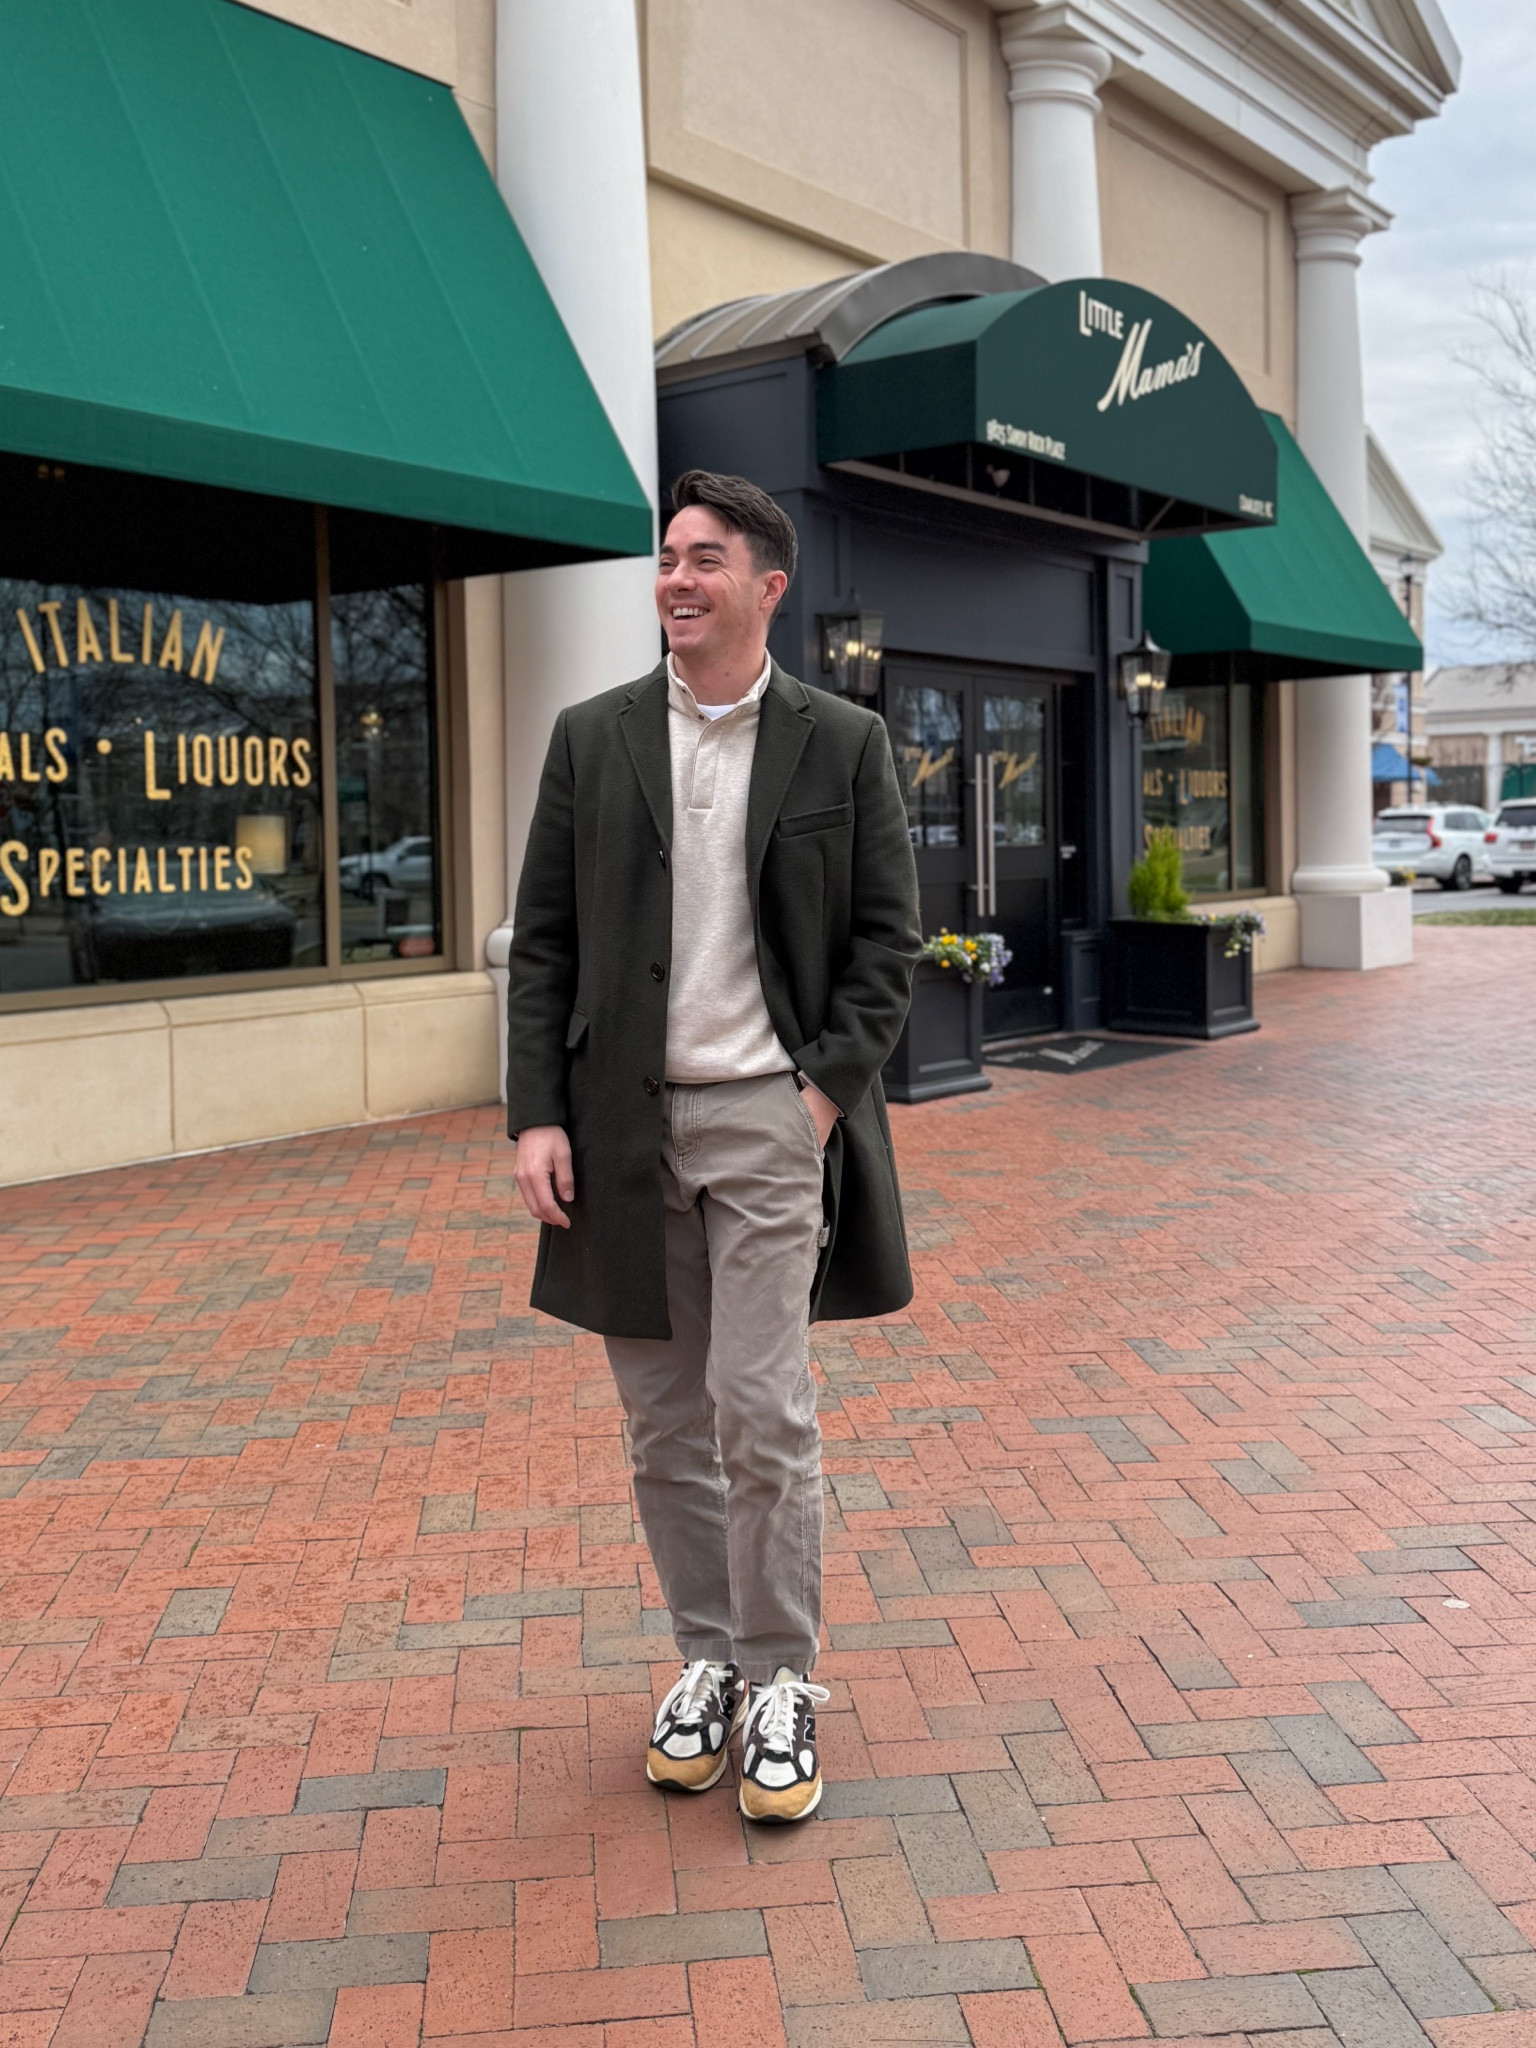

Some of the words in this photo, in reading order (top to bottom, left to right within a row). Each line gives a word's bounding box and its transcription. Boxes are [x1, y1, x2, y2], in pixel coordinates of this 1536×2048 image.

[1079, 289, 1124, 340] LITTLE
[1096, 318, 1205, 412] Mama's
[16, 597, 226, 685] ITALIAN
[145, 730, 312, 800] LIQUORS
[0, 839, 253, 916] SPECIALTIES
